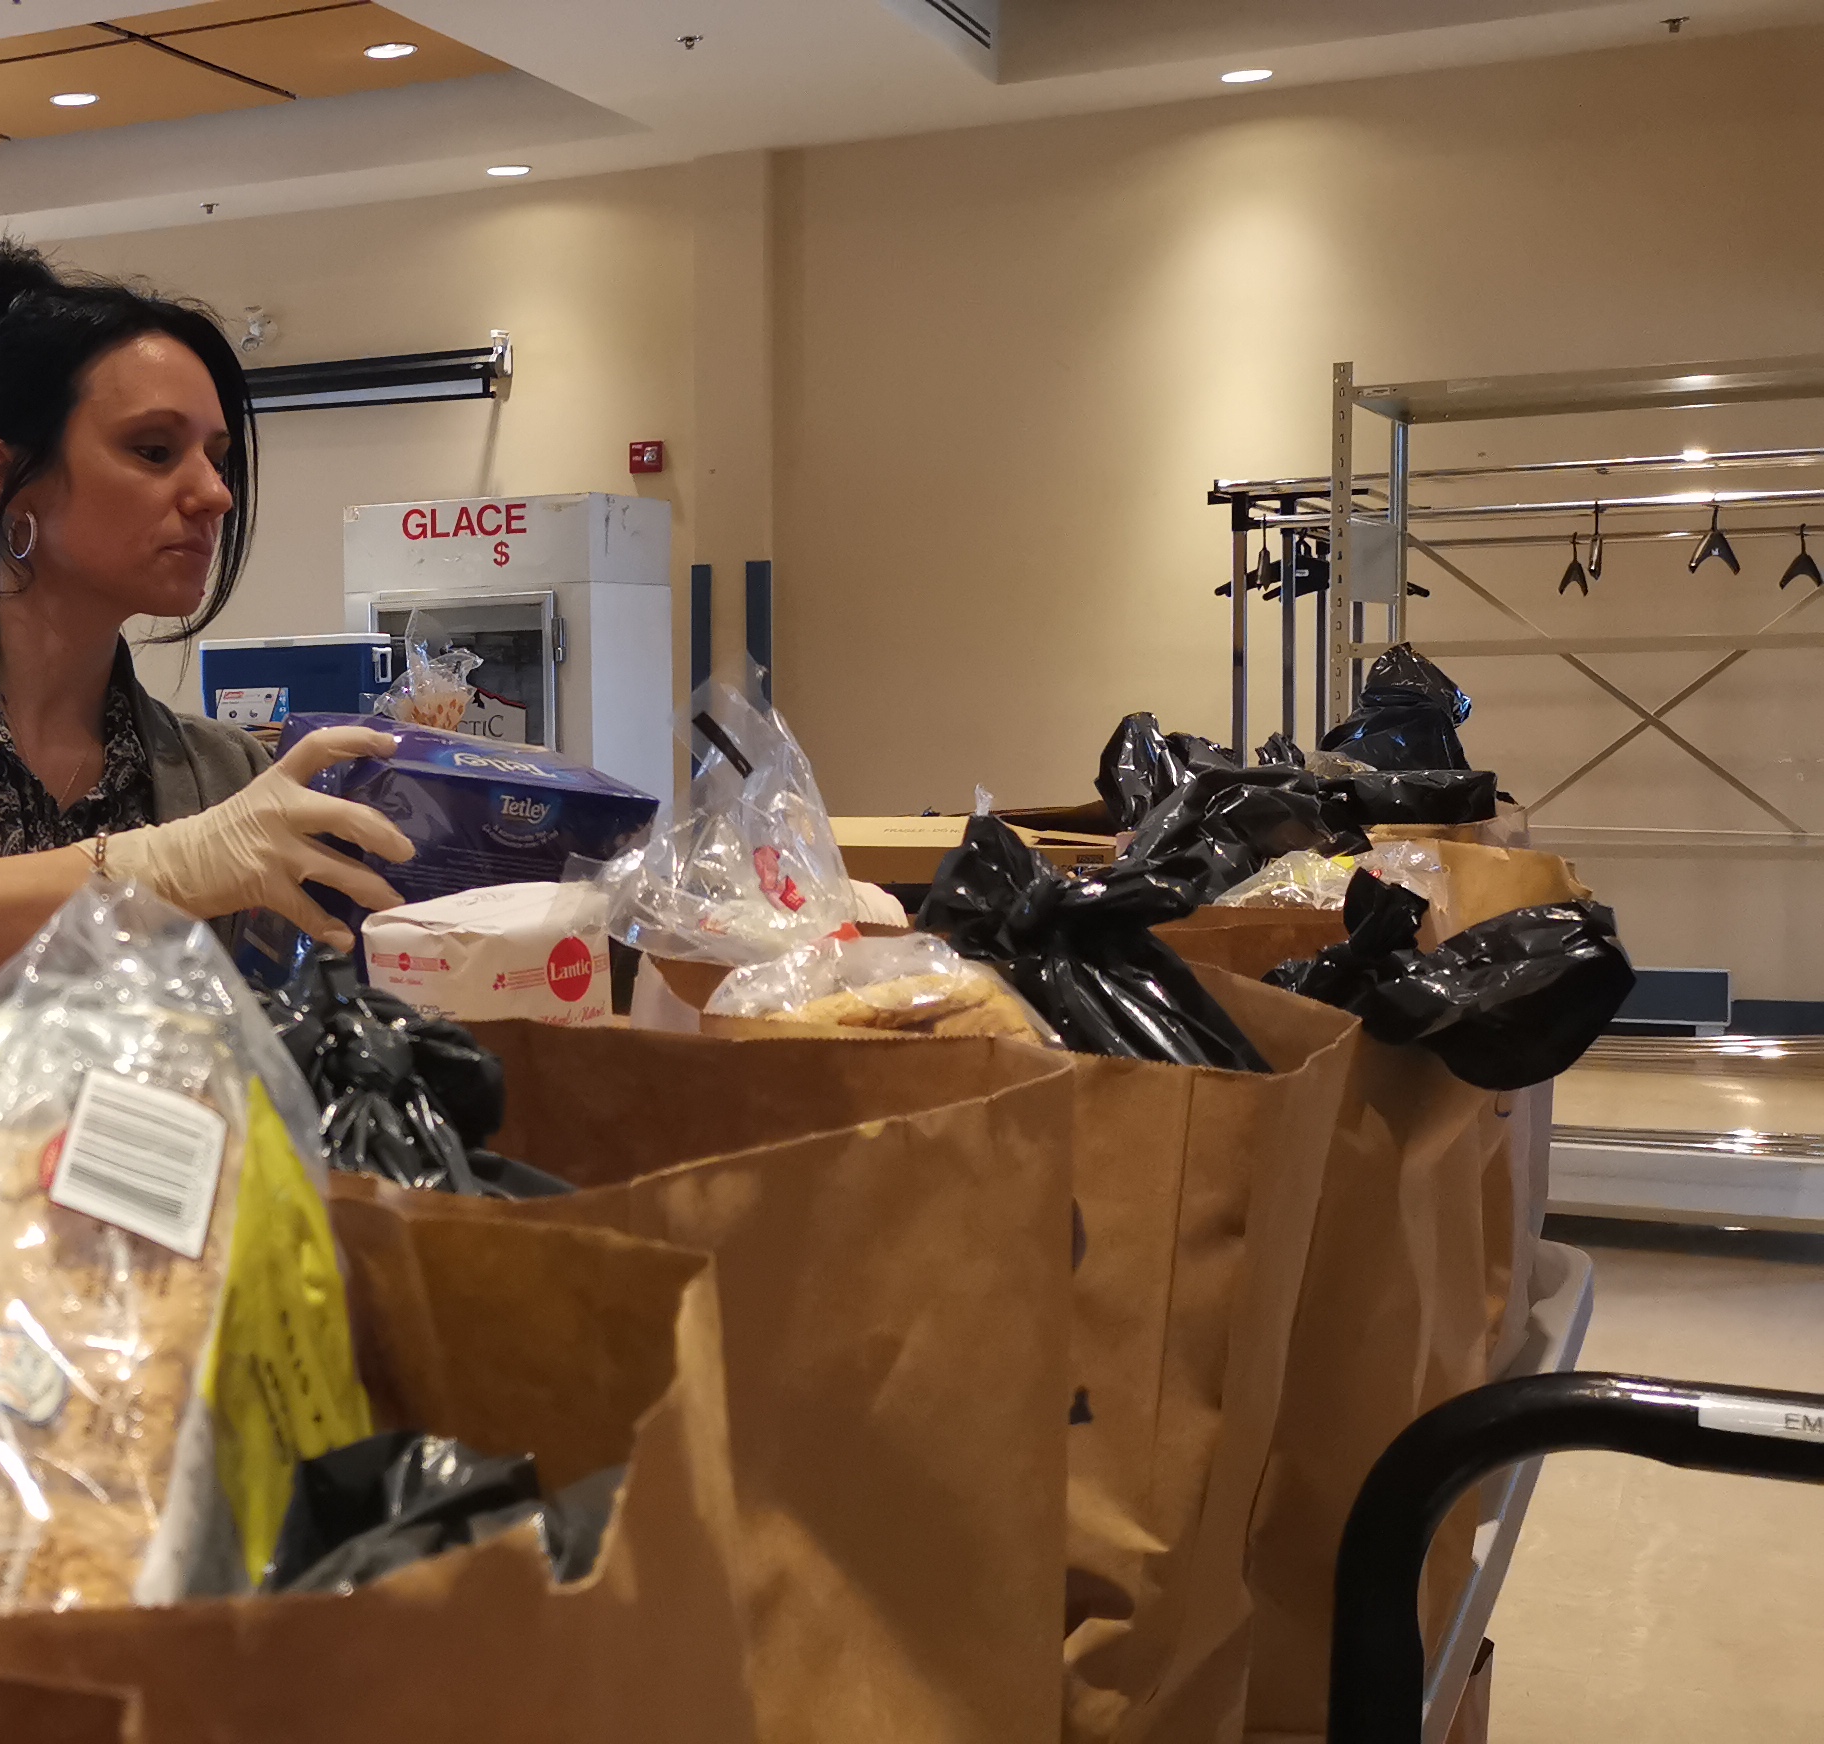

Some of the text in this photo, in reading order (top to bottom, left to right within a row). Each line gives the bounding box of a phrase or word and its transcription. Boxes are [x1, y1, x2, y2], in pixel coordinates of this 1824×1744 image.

[402, 503, 527, 540] GLACE
[493, 540, 510, 568] $
[500, 795, 551, 824] Tetley
[549, 959, 591, 981] Lantic
